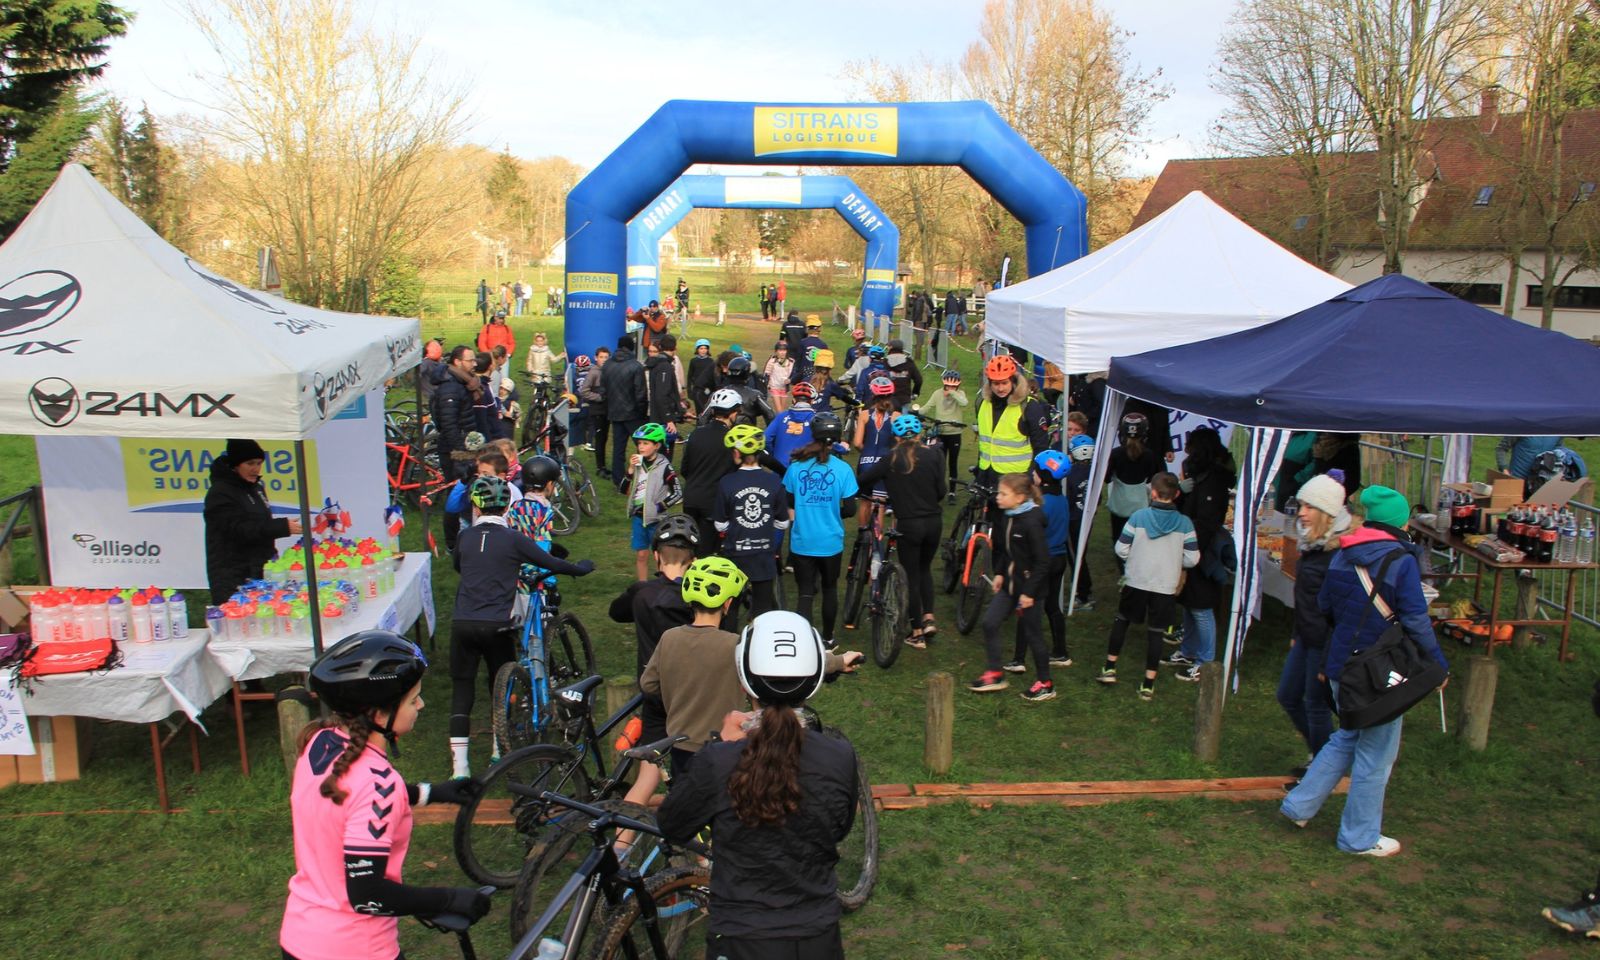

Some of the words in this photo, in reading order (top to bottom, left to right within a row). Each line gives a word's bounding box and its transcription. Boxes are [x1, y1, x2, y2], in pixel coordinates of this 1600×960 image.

[772, 112, 880, 129] SITRANS
[772, 133, 878, 142] LOGISTIQUE
[642, 190, 683, 231] DEPART
[841, 193, 883, 232] DEPART
[571, 274, 612, 284] SITRANS
[568, 300, 616, 310] www.sitrans.fr
[325, 360, 362, 402] 24MX
[85, 391, 240, 418] 24MX
[735, 486, 770, 499] TRIATHLON
